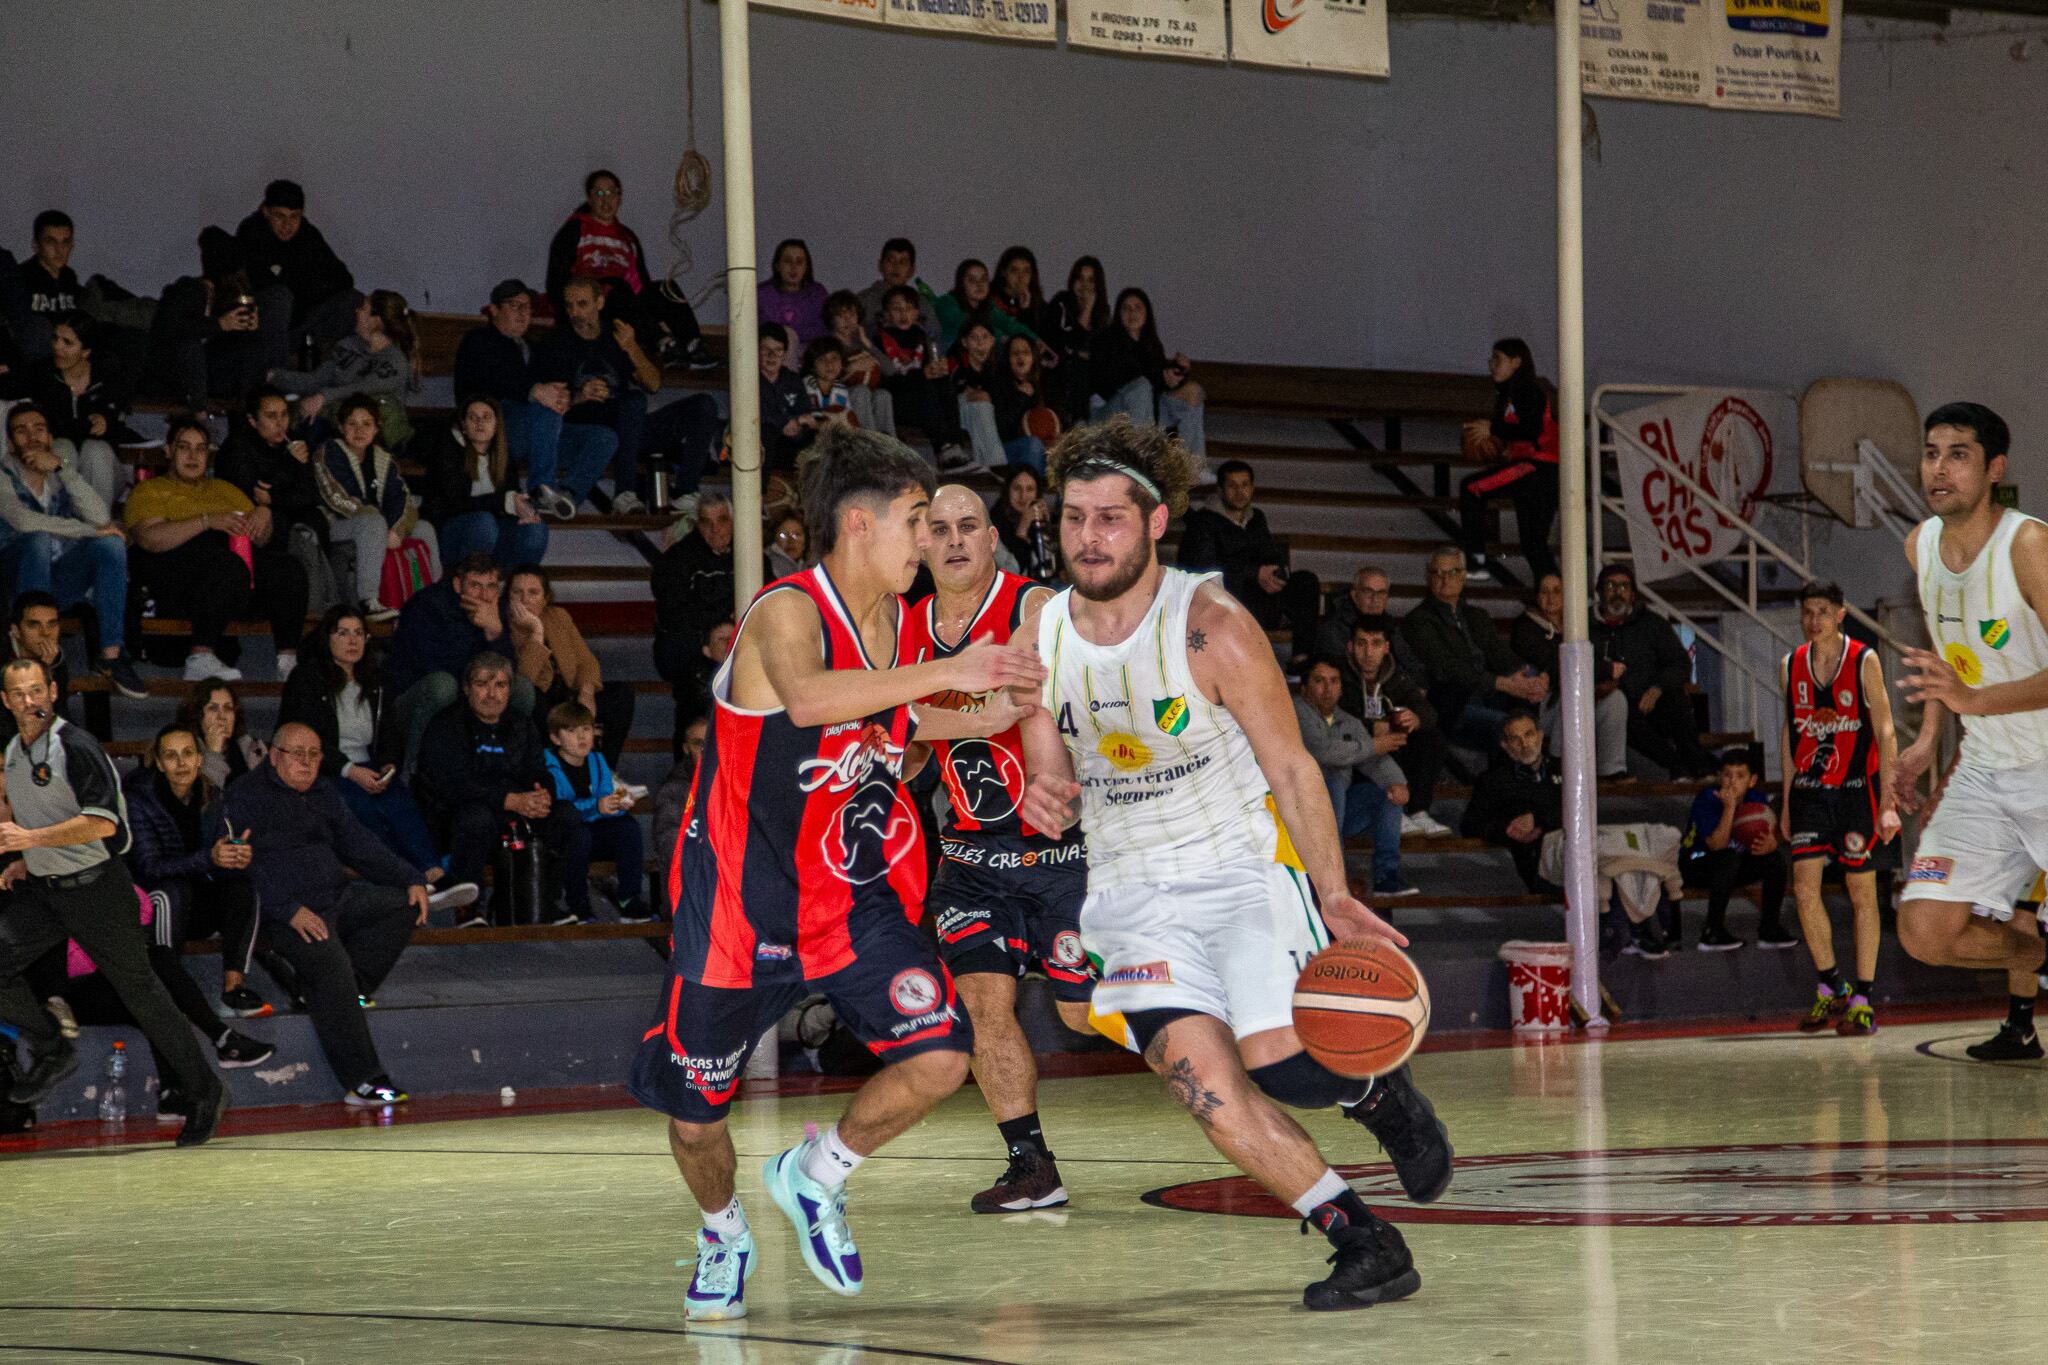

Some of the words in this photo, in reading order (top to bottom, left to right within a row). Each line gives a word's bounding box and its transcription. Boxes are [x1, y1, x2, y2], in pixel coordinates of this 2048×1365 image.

[1154, 34, 1194, 47] 430611
[1798, 681, 1808, 705] 9
[1101, 701, 1130, 709] KION
[1794, 714, 1862, 742] Argentino
[1105, 787, 1174, 807] Seguros
[1313, 963, 1381, 985] molten
[671, 1053, 713, 1070] PLACAS
[716, 1058, 724, 1070] Y
